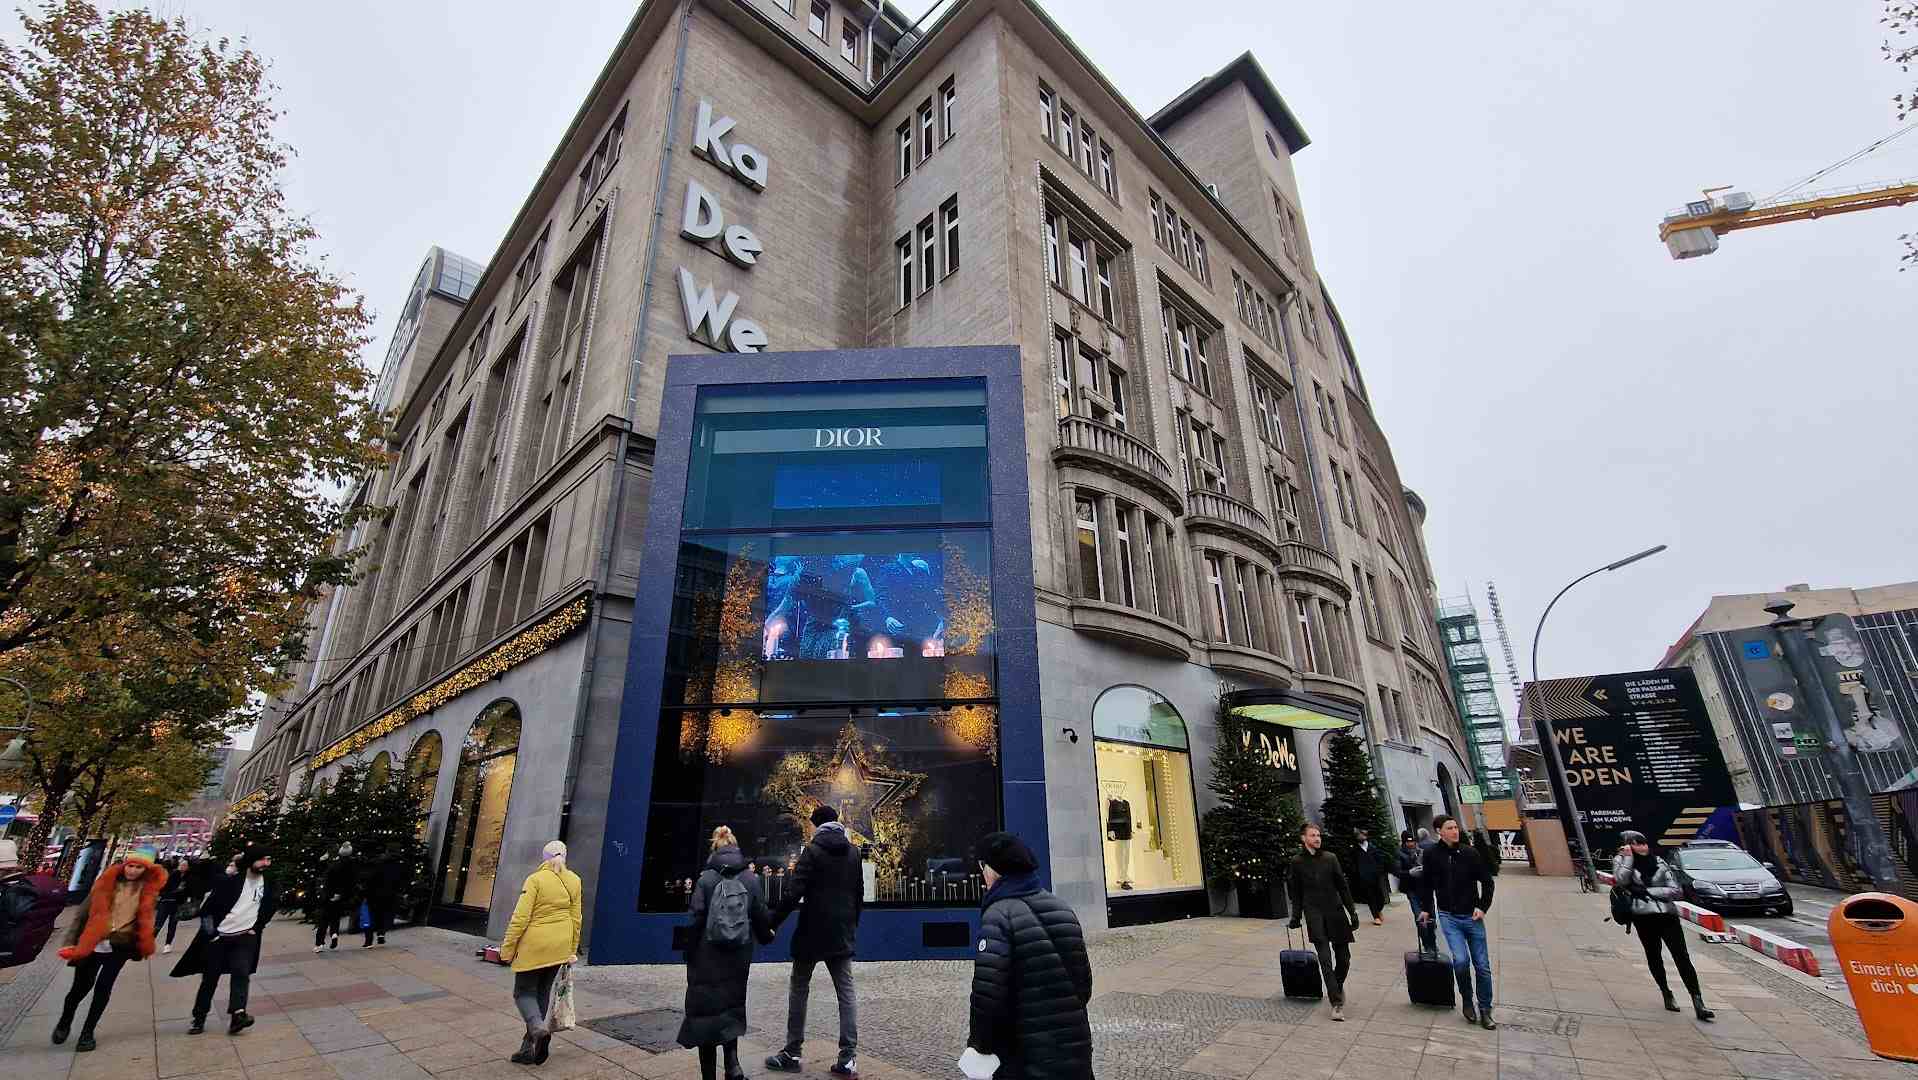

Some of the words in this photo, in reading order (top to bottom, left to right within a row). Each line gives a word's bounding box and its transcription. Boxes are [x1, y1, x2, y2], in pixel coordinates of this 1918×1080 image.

[691, 97, 769, 192] Ka
[680, 176, 764, 270] De
[675, 263, 769, 353] We
[815, 427, 884, 448] DIOR
[1551, 727, 1588, 745] WE
[1569, 745, 1617, 765] ARE
[1566, 766, 1633, 786] OPEN
[1850, 960, 1892, 976] Eimer
[1871, 978, 1905, 995] dich
